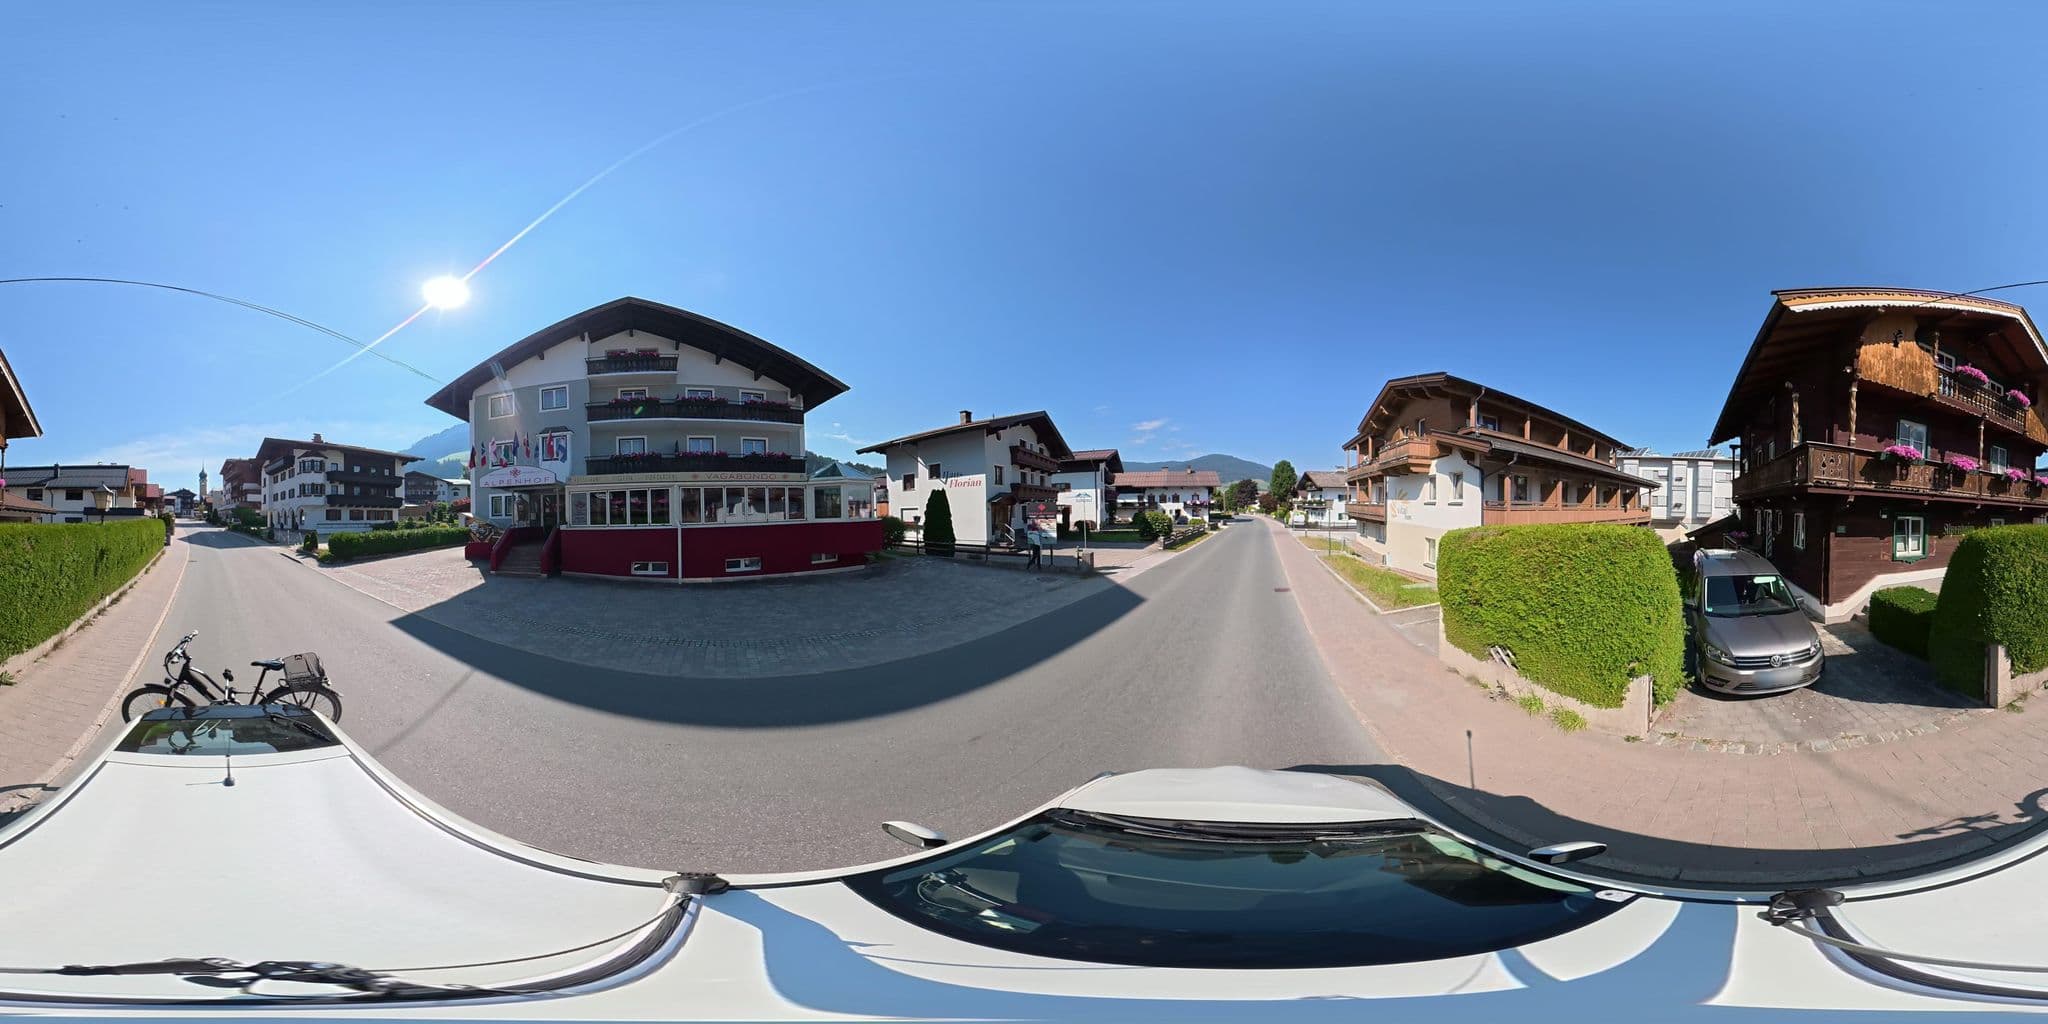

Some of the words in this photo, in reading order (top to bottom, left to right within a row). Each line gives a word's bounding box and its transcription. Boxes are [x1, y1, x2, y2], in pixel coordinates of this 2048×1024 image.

[483, 476, 551, 487] ALPENHOF
[704, 472, 777, 480] VAGABONDO
[949, 477, 982, 489] Florian
